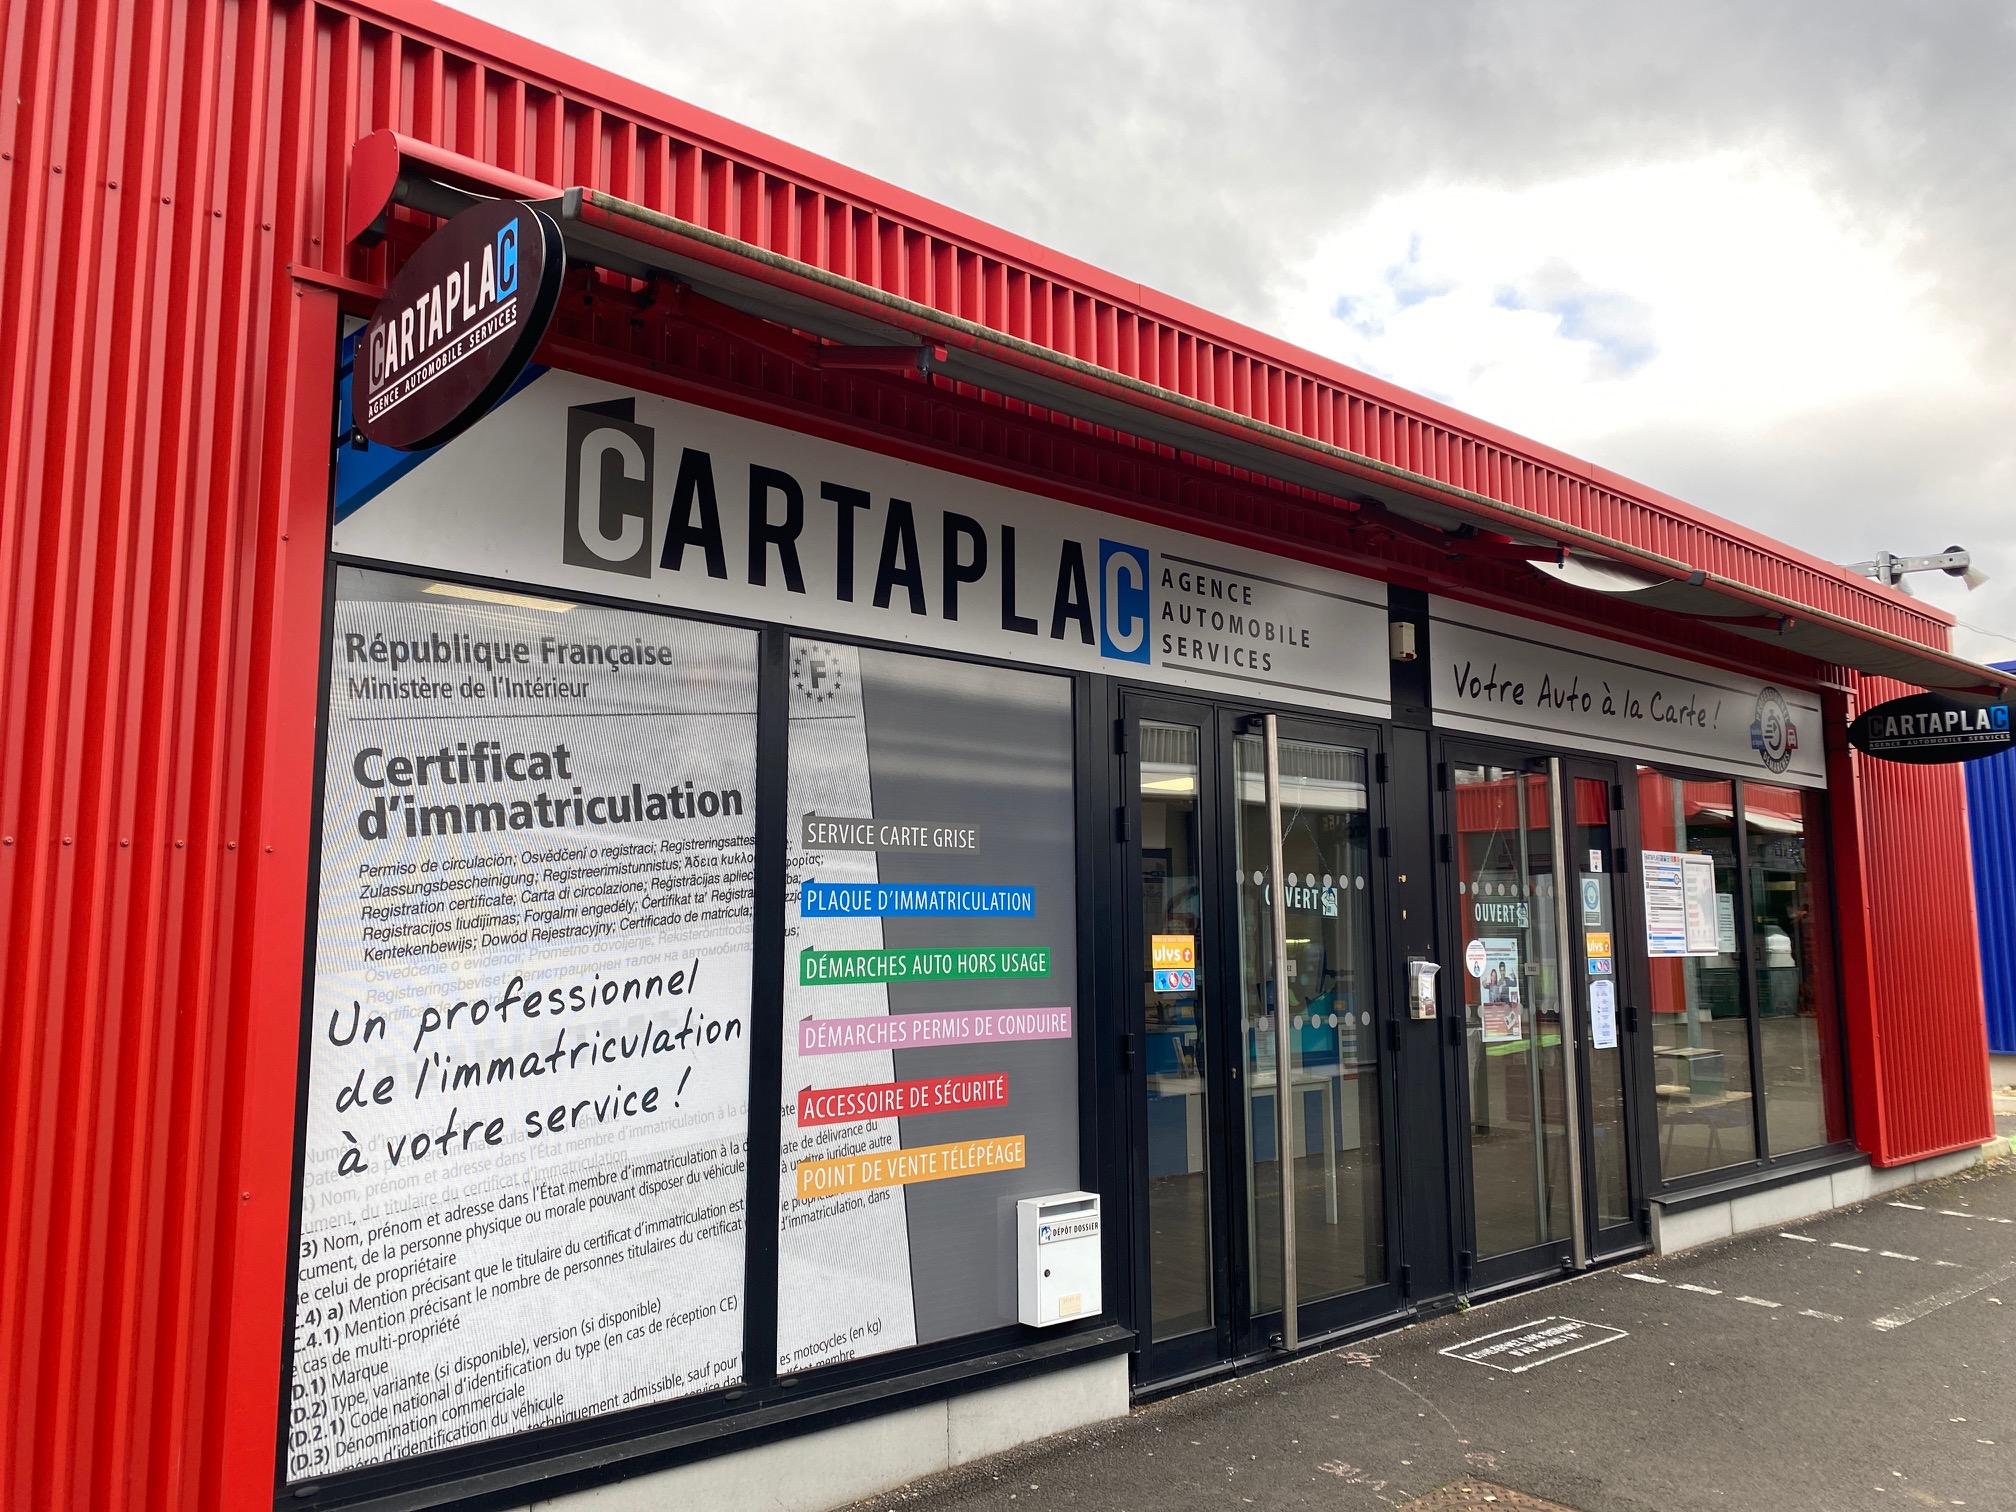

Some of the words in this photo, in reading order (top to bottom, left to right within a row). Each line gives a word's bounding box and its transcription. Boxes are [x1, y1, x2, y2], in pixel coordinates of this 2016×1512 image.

[369, 218, 518, 393] CARTAPLAC
[368, 388, 399, 418] AGENCE
[405, 344, 462, 391] AUTOMOBILE
[469, 304, 517, 348] SERVICES
[565, 410, 1149, 660] CARTAPLAC
[1161, 567, 1252, 605] AGENCE
[1162, 600, 1310, 648] AUTOMOBILE
[345, 631, 530, 672] République
[541, 636, 673, 673] Française
[1162, 633, 1272, 671] SERVICES
[348, 676, 453, 700] Ministère
[460, 676, 486, 699] de
[492, 676, 590, 699] l'Intérieur
[809, 660, 827, 689] F
[1453, 661, 1524, 705] Votre
[1537, 673, 1592, 713] Auto
[1601, 681, 1616, 716] à
[1624, 689, 1643, 719] la
[1650, 690, 1707, 728] Carte
[1868, 705, 2010, 739] CARTAPLAC
[1908, 737, 1962, 746] AUTOMOBILE
[1969, 733, 2011, 742] SERVICES
[353, 740, 572, 789] Certificat
[357, 780, 744, 841] d'immatriculation
[807, 822, 874, 845] SERVICE
[880, 825, 928, 847] CARTE
[933, 828, 976, 849] GRISE
[359, 863, 416, 878] Permiso
[421, 859, 438, 873] de
[442, 853, 517, 871] circulación;
[521, 845, 587, 865] Osvědčení
[601, 842, 657, 861] registraci;
[359, 871, 539, 900] Zulassungsbescheinigung;
[361, 900, 445, 921] Registration
[449, 894, 517, 911] certificate;
[521, 889, 555, 904] Carta
[559, 887, 571, 900] di
[574, 880, 648, 898] circolazione;
[807, 890, 872, 912] PLAQUE
[1265, 886, 1319, 909] VERT
[363, 921, 452, 942] Registracijos
[456, 913, 520, 932] liudijimas;
[524, 903, 578, 925] Forgalmi
[581, 898, 638, 918] engedély;
[364, 936, 477, 962] Kentekenbewijs;
[482, 930, 528, 948] Dowód
[531, 921, 616, 944] Rejestracyjny;
[620, 912, 681, 930] Certificado
[684, 911, 698, 924] de
[701, 905, 753, 921] matrícula;
[1475, 902, 1515, 922] OUVERT
[806, 952, 907, 979] DÉMARCHES
[912, 955, 953, 975] AUTO
[958, 954, 996, 973] HORS
[1001, 953, 1047, 972] USAGE
[1154, 944, 1181, 962] ulys
[328, 999, 387, 1047] Un
[412, 957, 699, 1051] professionnel
[805, 1019, 907, 1049] DÉMARCHES
[913, 1017, 970, 1041] PERMIS
[975, 1016, 993, 1036] DE
[997, 1013, 1068, 1035] CONDUIRE
[335, 1069, 395, 1113] de
[413, 1007, 742, 1099] l'immatriculation
[804, 1086, 904, 1120] ACCESSOIRE
[909, 1087, 929, 1108] DE
[934, 1076, 1004, 1106] SÉCURITÉ
[337, 1130, 369, 1177] à
[387, 1106, 504, 1165] votre
[526, 1084, 660, 1139] service
[674, 1066, 692, 1108] !
[816, 1125, 864, 1146] délivrance
[869, 1133, 892, 1150] autre
[803, 1162, 856, 1191] POINT
[862, 1160, 882, 1184] DE
[887, 1152, 937, 1179] VENTE
[942, 1141, 1023, 1169] TÉLÉPÉAGE
[323, 1230, 363, 1253] Nom,
[367, 1217, 422, 1245] prénom
[427, 1213, 441, 1227] et
[445, 1199, 495, 1223] adresse
[498, 1193, 529, 1210] dans
[569, 1169, 617, 1194] membre
[361, 1247, 379, 1266] de
[384, 1243, 396, 1260] la
[400, 1230, 462, 1261] personne
[466, 1213, 522, 1244] physique
[525, 1210, 542, 1224] ou
[545, 1195, 586, 1221] morale
[589, 1185, 636, 1212] pouvant
[639, 1173, 684, 1201] disposer
[687, 1167, 701, 1184] du
[703, 1160, 745, 1180] véhicule
[868, 1189, 891, 1205] dans
[1053, 1226, 1072, 1237] DÉPÔT
[1074, 1222, 1099, 1233] DOSSIER
[314, 1279, 349, 1301] celui
[353, 1273, 371, 1291] de
[376, 1252, 457, 1285] propriétaire
[345, 1310, 405, 1339] Mention
[410, 1292, 472, 1321] précisant
[476, 1286, 488, 1302] le
[491, 1272, 541, 1298] nombre
[544, 1267, 560, 1282] de
[563, 1249, 625, 1281] personnes
[627, 1235, 676, 1260] titulaires
[680, 1230, 694, 1246] du
[696, 1217, 743, 1241] certificat
[349, 1286, 408, 1315] Mention
[411, 1268, 471, 1299] précisant
[474, 1260, 498, 1281] que
[516, 1246, 562, 1269] titulaire
[565, 1239, 581, 1256] du
[583, 1226, 632, 1252] certificat
[303, 1356, 328, 1374] cas
[332, 1347, 351, 1365] de
[355, 1313, 461, 1359] multi-propriété
[333, 1389, 369, 1413] Type,
[373, 1370, 430, 1398] variante
[454, 1337, 530, 1374] disponible),
[533, 1327, 578, 1349] version
[598, 1297, 662, 1329] disponible)
[794, 1333, 848, 1361] motocycles
[867, 1317, 882, 1336] kg)
[331, 1360, 389, 1389] Marque
[350, 1406, 388, 1430] Code
[393, 1383, 450, 1415] national
[575, 1338, 600, 1360] type
[666, 1304, 717, 1330] réception
[719, 1295, 738, 1313] CE)
[623, 1373, 685, 1404] admissible,
[688, 1361, 711, 1384] sauf
[713, 1354, 738, 1377] pour
[290, 1445, 330, 1476] (D.3)
[336, 1413, 438, 1457] Dénomination
[442, 1383, 525, 1422] commerciale
[491, 1411, 508, 1429] du
[512, 1391, 564, 1420] véhicule
